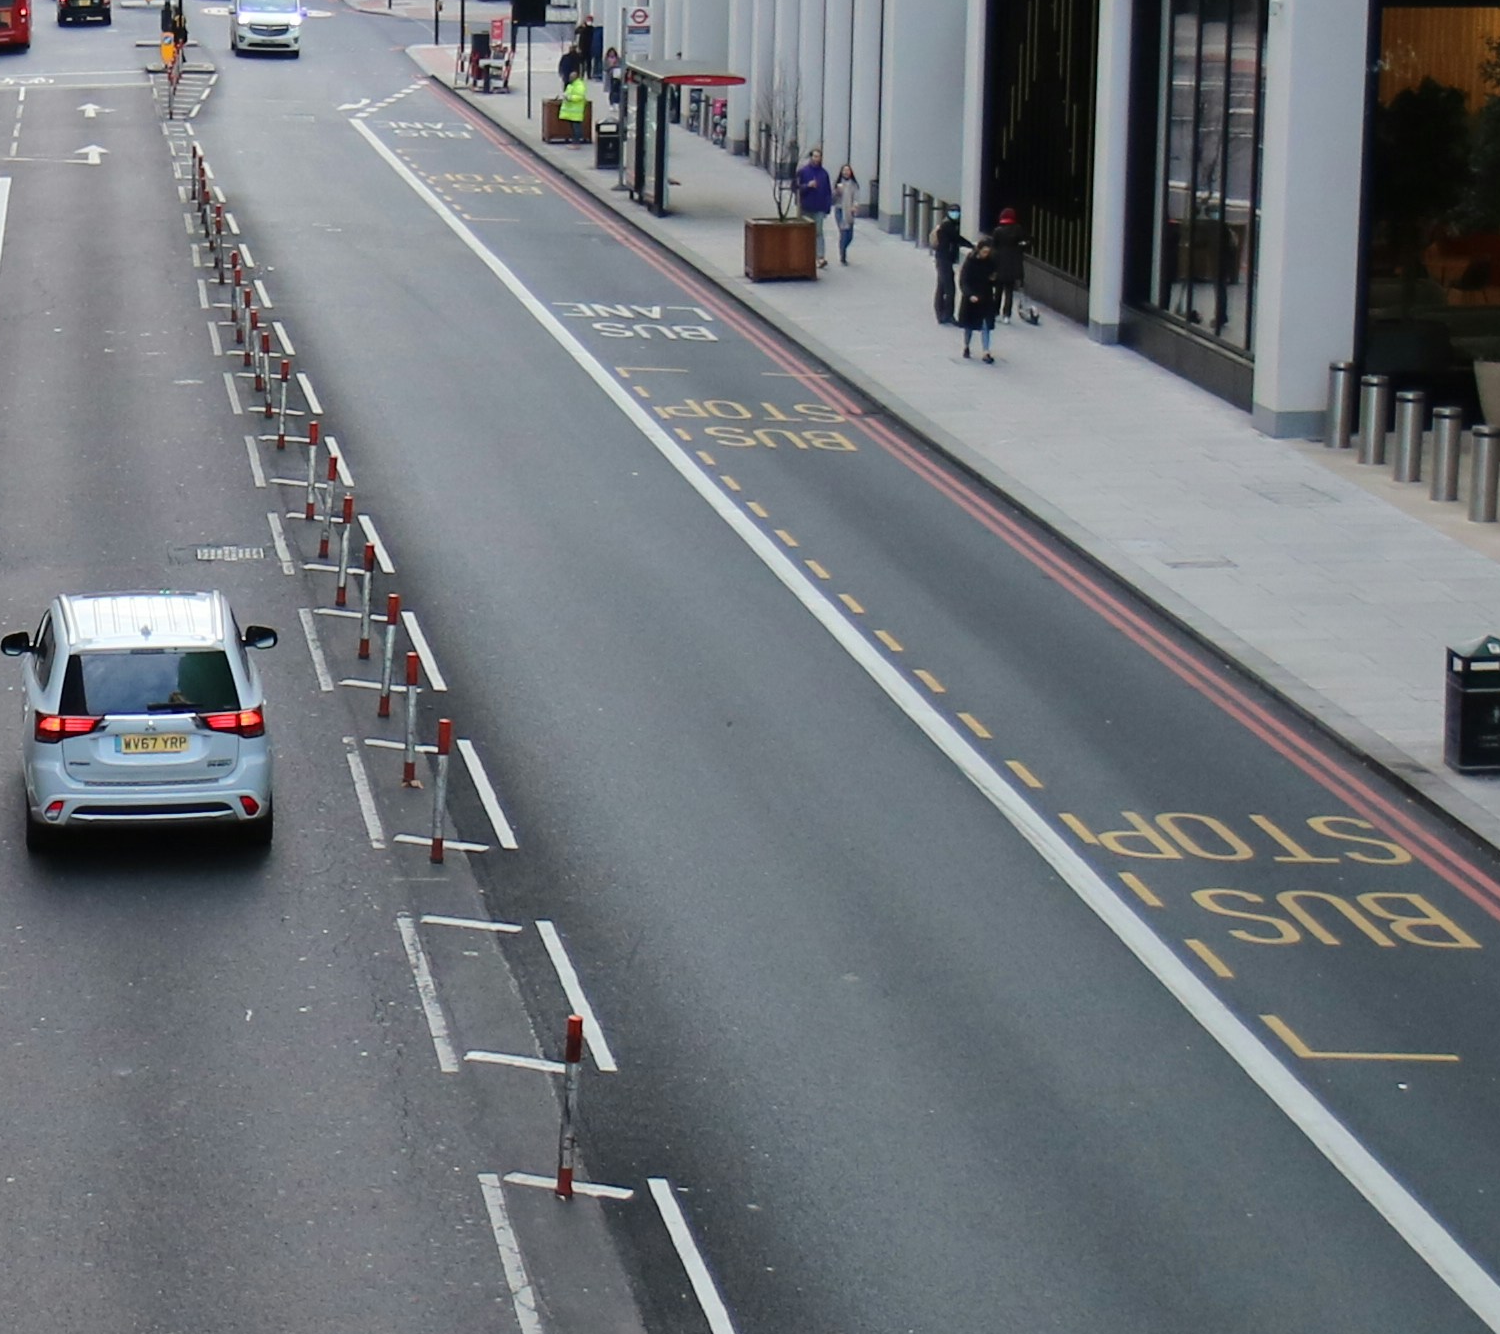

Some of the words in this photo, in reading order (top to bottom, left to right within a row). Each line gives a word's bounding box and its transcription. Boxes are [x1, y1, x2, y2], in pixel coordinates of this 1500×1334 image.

[551, 302, 714, 322] LANE
[592, 322, 719, 342] BUS
[655, 398, 846, 423] STOP
[704, 426, 859, 452] BUS
[124, 737, 158, 750] WV67
[161, 736, 187, 749] YRP
[1098, 810, 1413, 866] STOP
[1190, 888, 1483, 950] BUS
